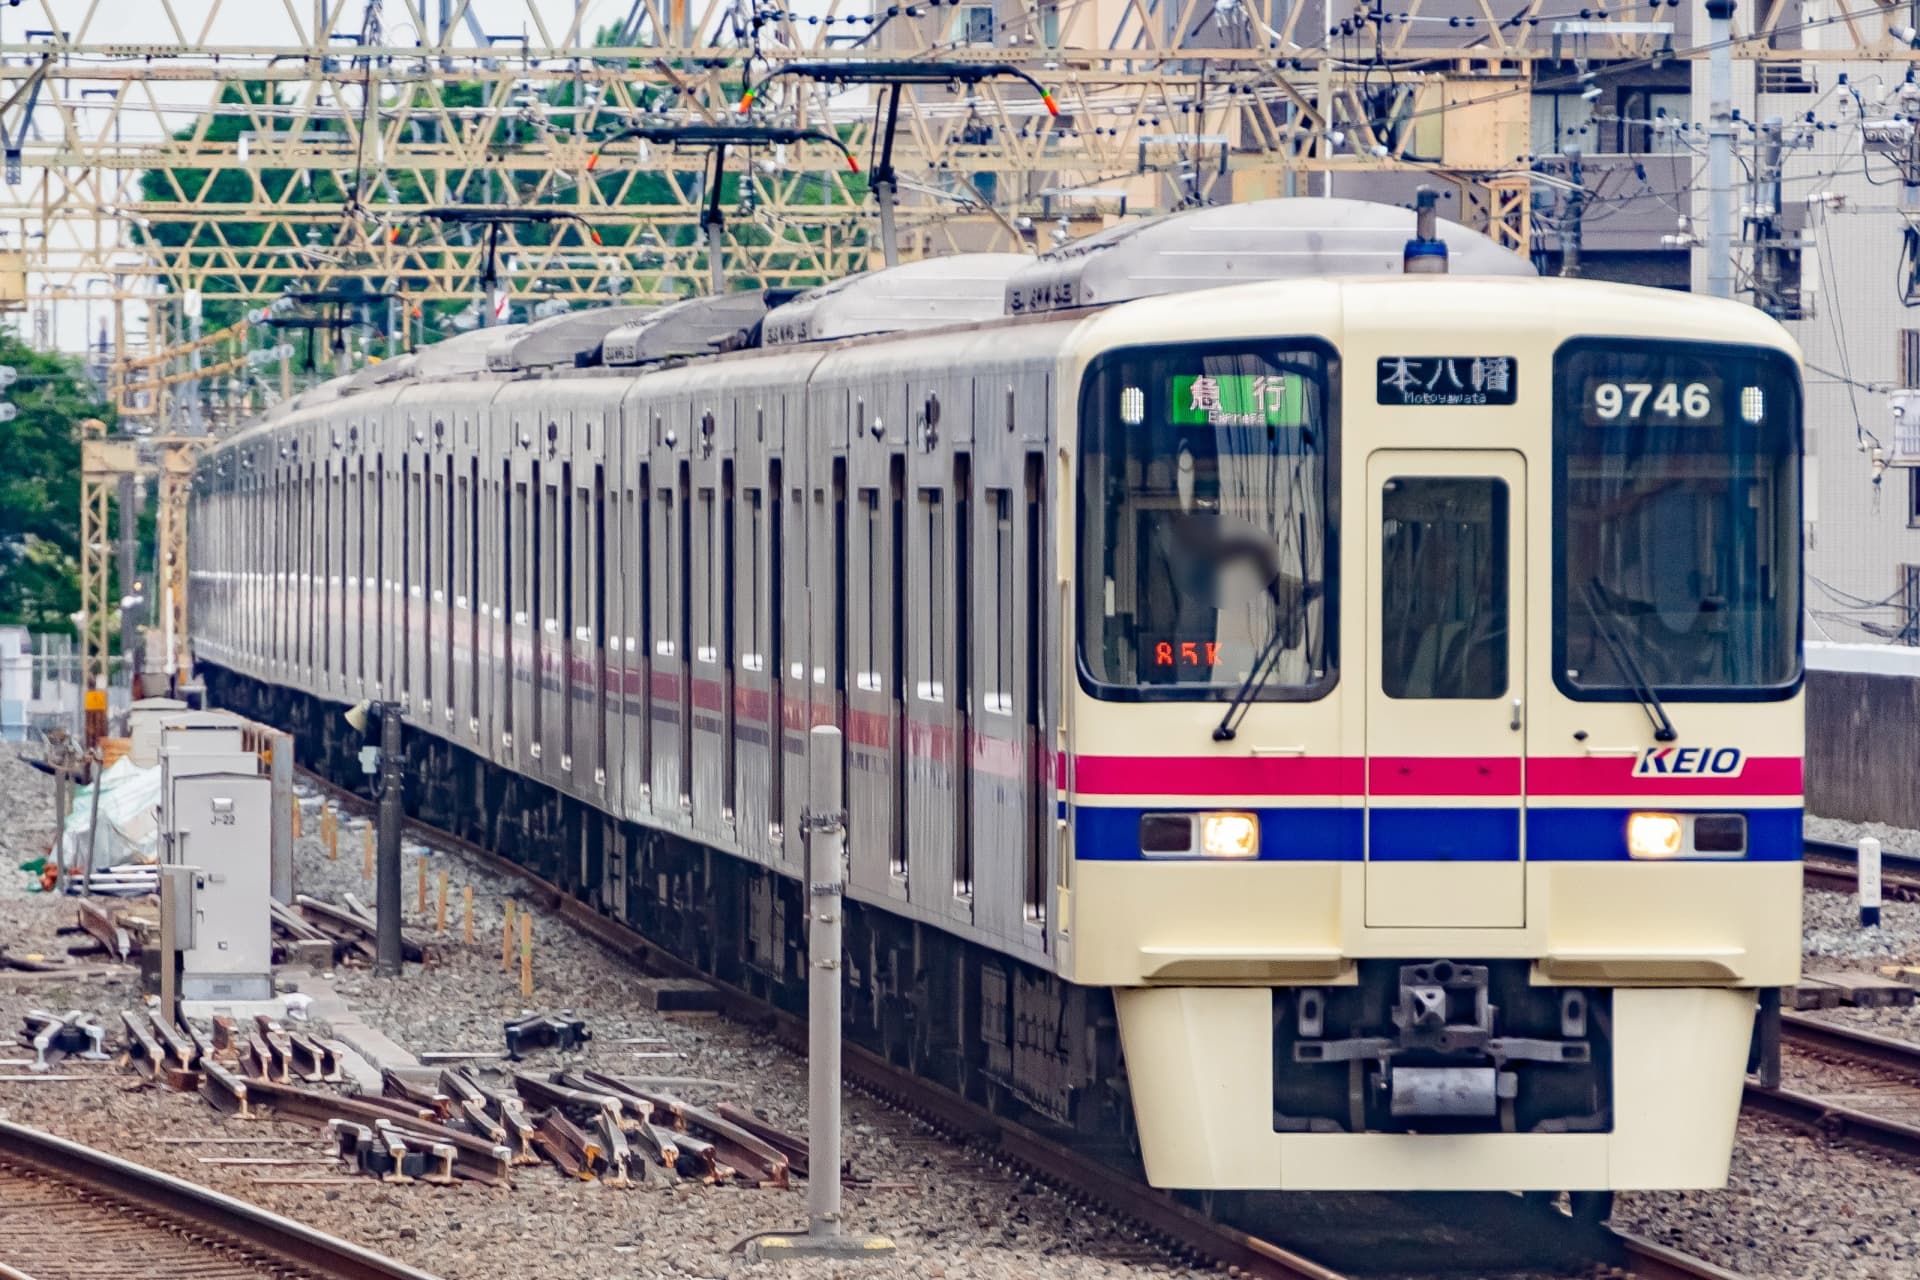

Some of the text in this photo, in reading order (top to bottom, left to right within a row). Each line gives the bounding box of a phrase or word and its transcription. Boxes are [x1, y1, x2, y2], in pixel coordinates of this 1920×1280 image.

[1190, 374, 1286, 411] 急行
[1382, 357, 1509, 392] 本八幡
[1595, 382, 1711, 419] 9746
[1639, 747, 1741, 774] KEIO
